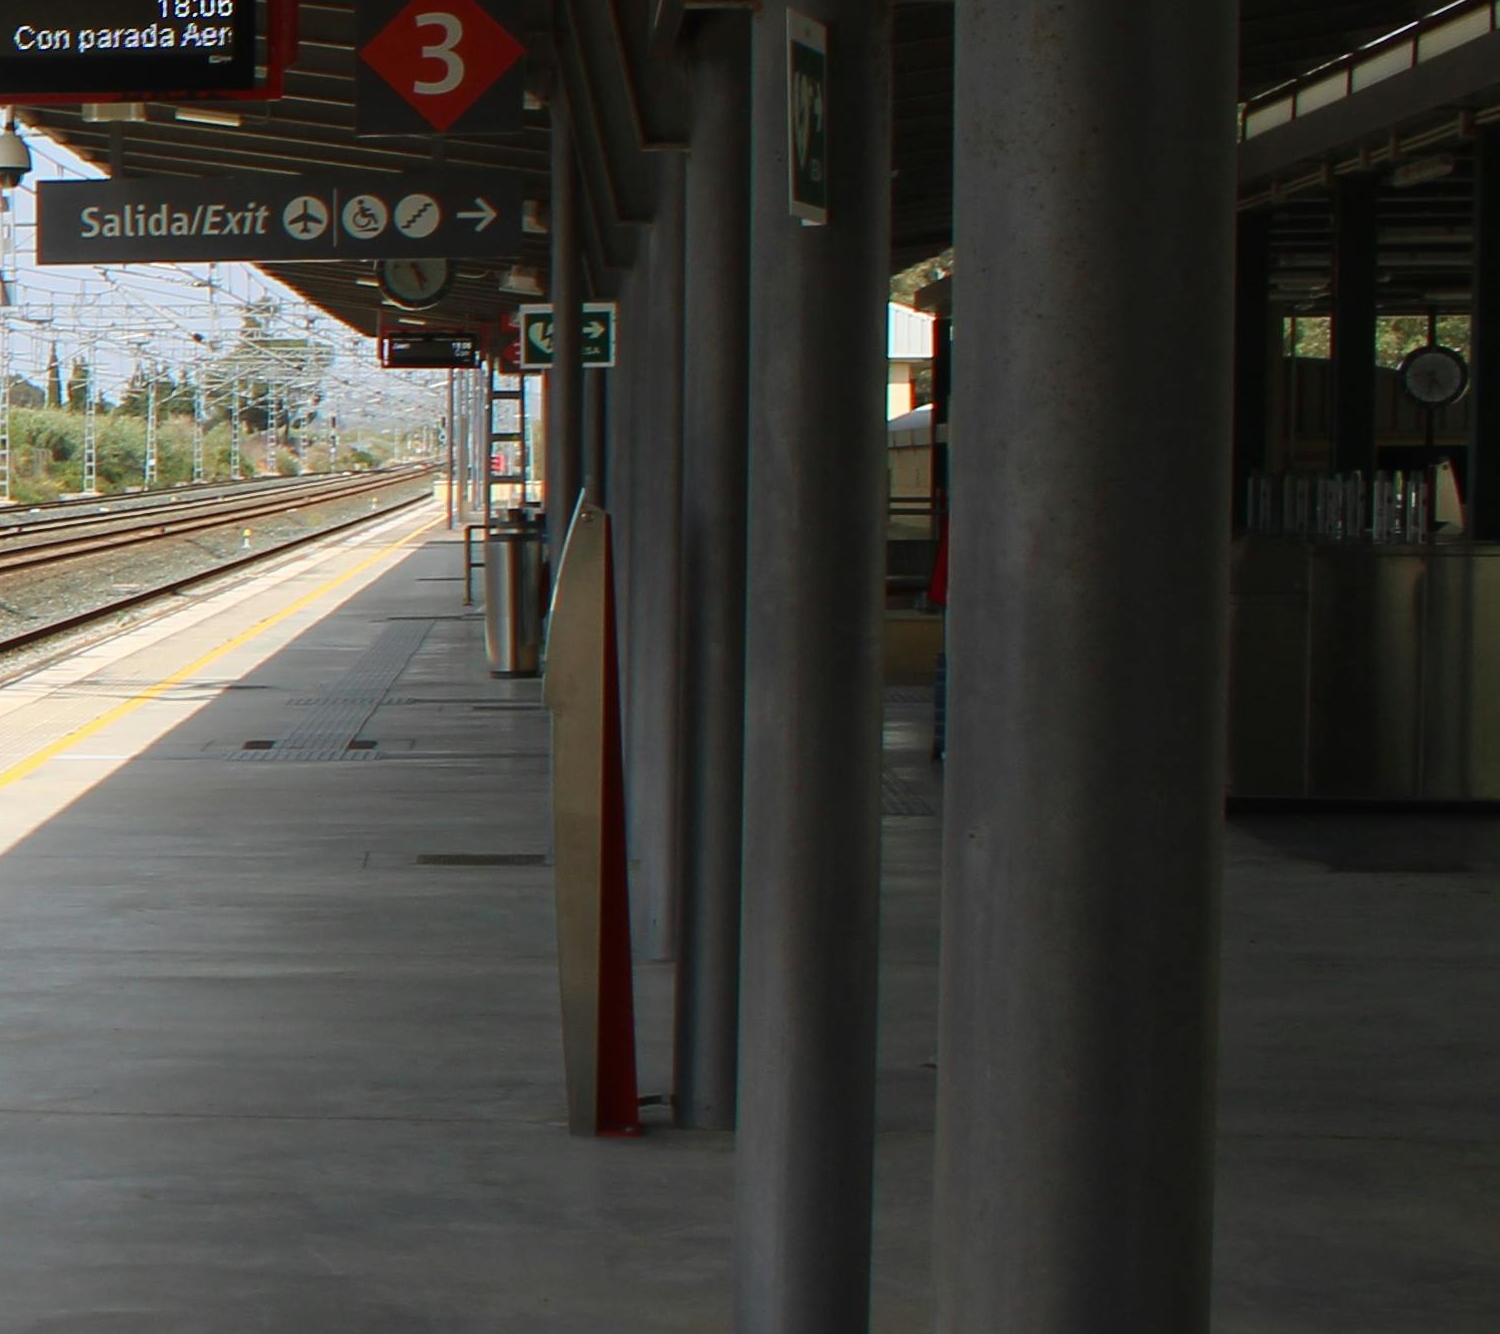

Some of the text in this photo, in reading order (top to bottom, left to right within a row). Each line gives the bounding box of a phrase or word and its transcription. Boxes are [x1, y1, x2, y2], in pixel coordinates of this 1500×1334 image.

[13, 22, 233, 53] Con parada Aer
[413, 11, 465, 95] 3
[80, 202, 270, 238] Salida/Exit
